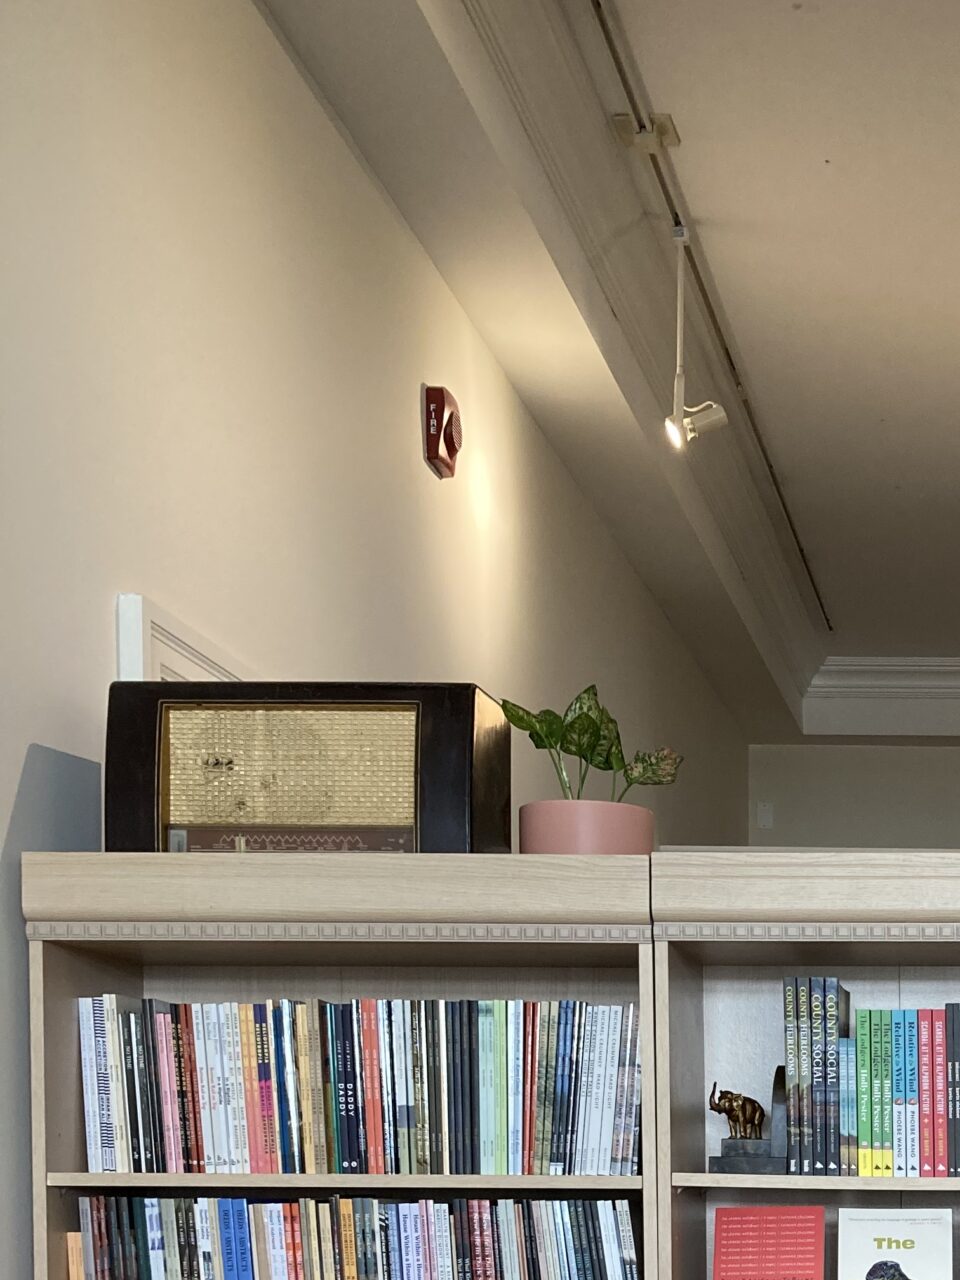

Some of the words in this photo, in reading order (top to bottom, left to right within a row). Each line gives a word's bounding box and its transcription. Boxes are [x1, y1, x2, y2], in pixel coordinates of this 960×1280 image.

[429, 403, 437, 435] FIRE
[785, 986, 794, 1021] COUNTY
[799, 986, 807, 1021] COUNTY
[812, 993, 822, 1041] COUNTY
[826, 994, 837, 1042] COUNTY
[786, 1023, 796, 1075] HEIRLOOMS
[893, 1021, 903, 1059] Relative
[935, 1020, 944, 1045] SCANDAL
[799, 1023, 808, 1076] HEIRLOOMS
[813, 1043, 822, 1084] SOCIAL
[827, 1044, 837, 1085] SOCIAL
[859, 1032, 868, 1067] Lodgers
[935, 1055, 944, 1064] THE
[859, 1069, 868, 1093] Holly
[894, 1067, 903, 1093] Wind
[935, 1065, 944, 1090] ALPHORN
[346, 1083, 354, 1117] DADDY
[860, 1095, 868, 1121] Pester
[936, 1091, 944, 1114] FACTORY
[402, 1213, 410, 1232] House
[403, 1235, 411, 1257] Within
[873, 1237, 916, 1250] The
